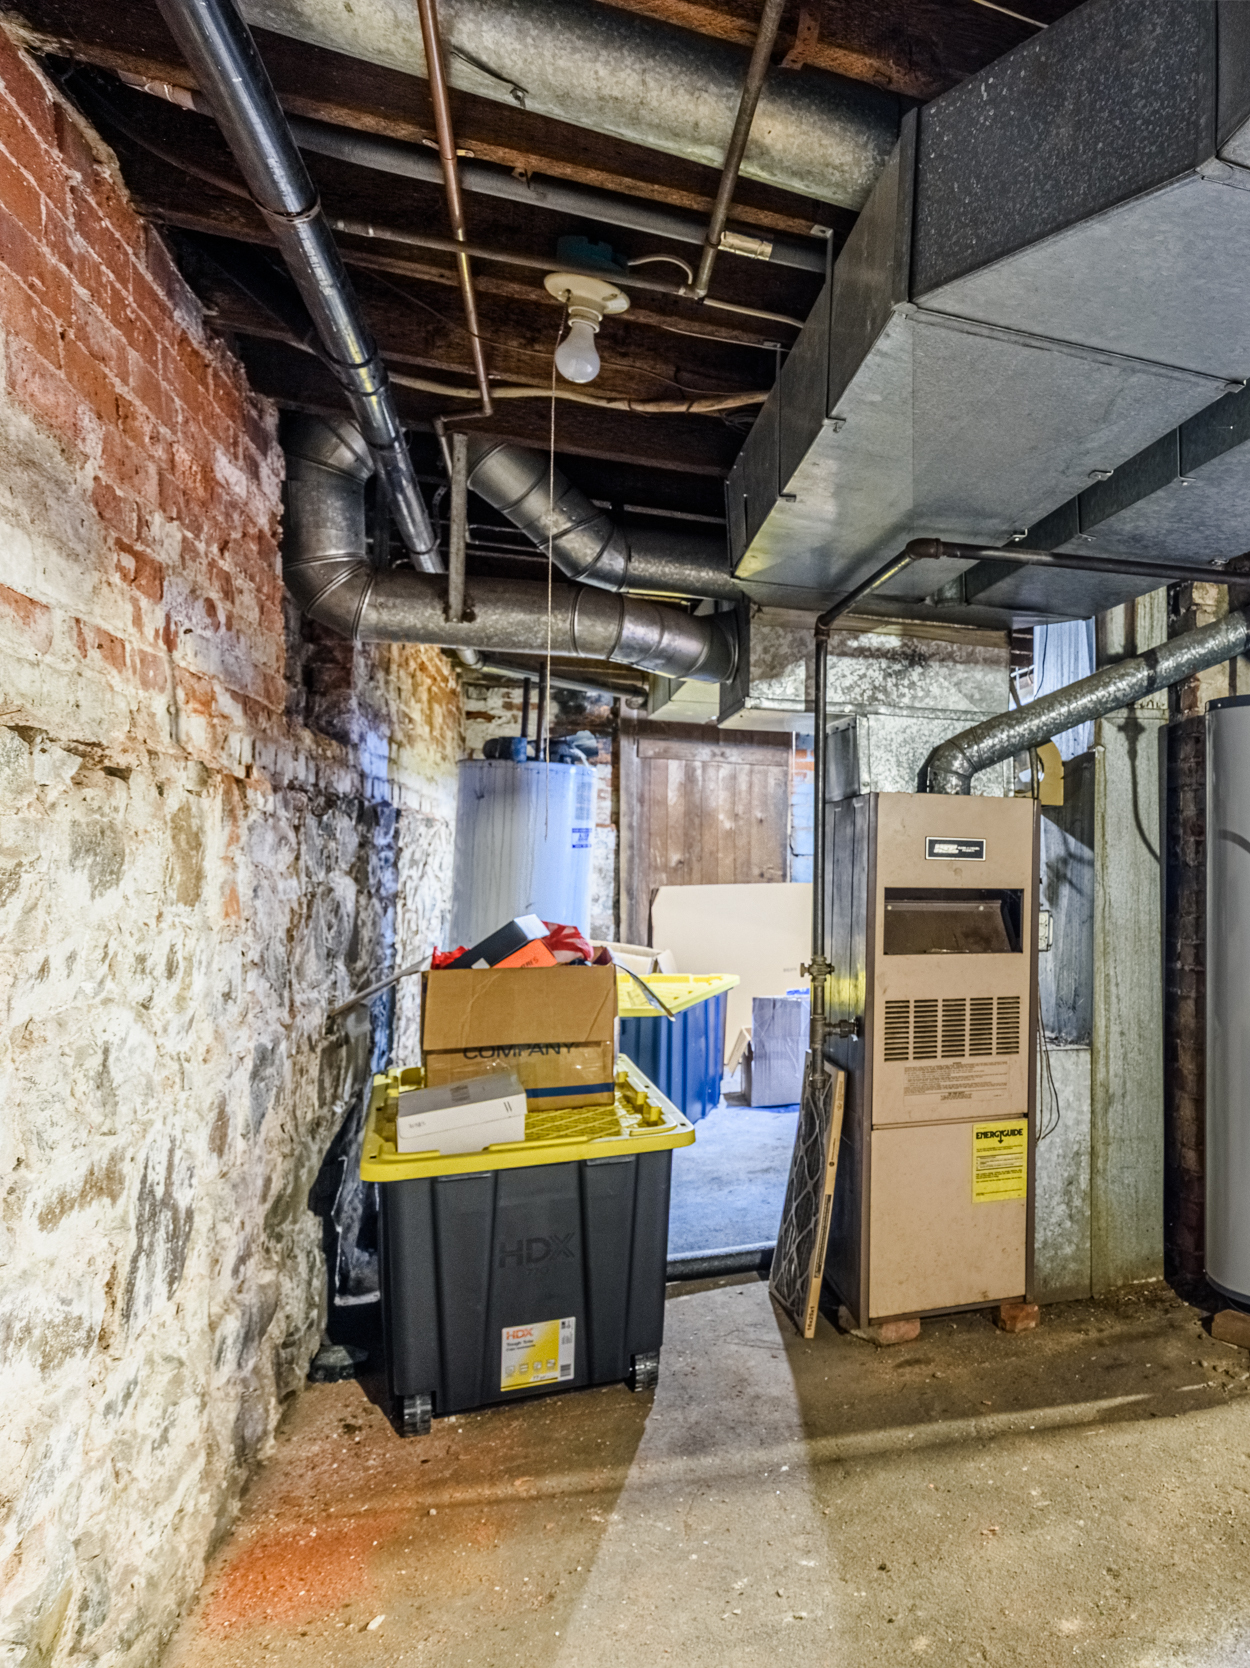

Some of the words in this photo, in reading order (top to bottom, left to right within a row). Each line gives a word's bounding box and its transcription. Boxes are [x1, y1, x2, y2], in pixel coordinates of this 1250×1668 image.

[976, 1129, 1023, 1140] ENERGYGUIDE
[499, 1232, 575, 1267] HDX
[506, 1328, 534, 1340] HDX
